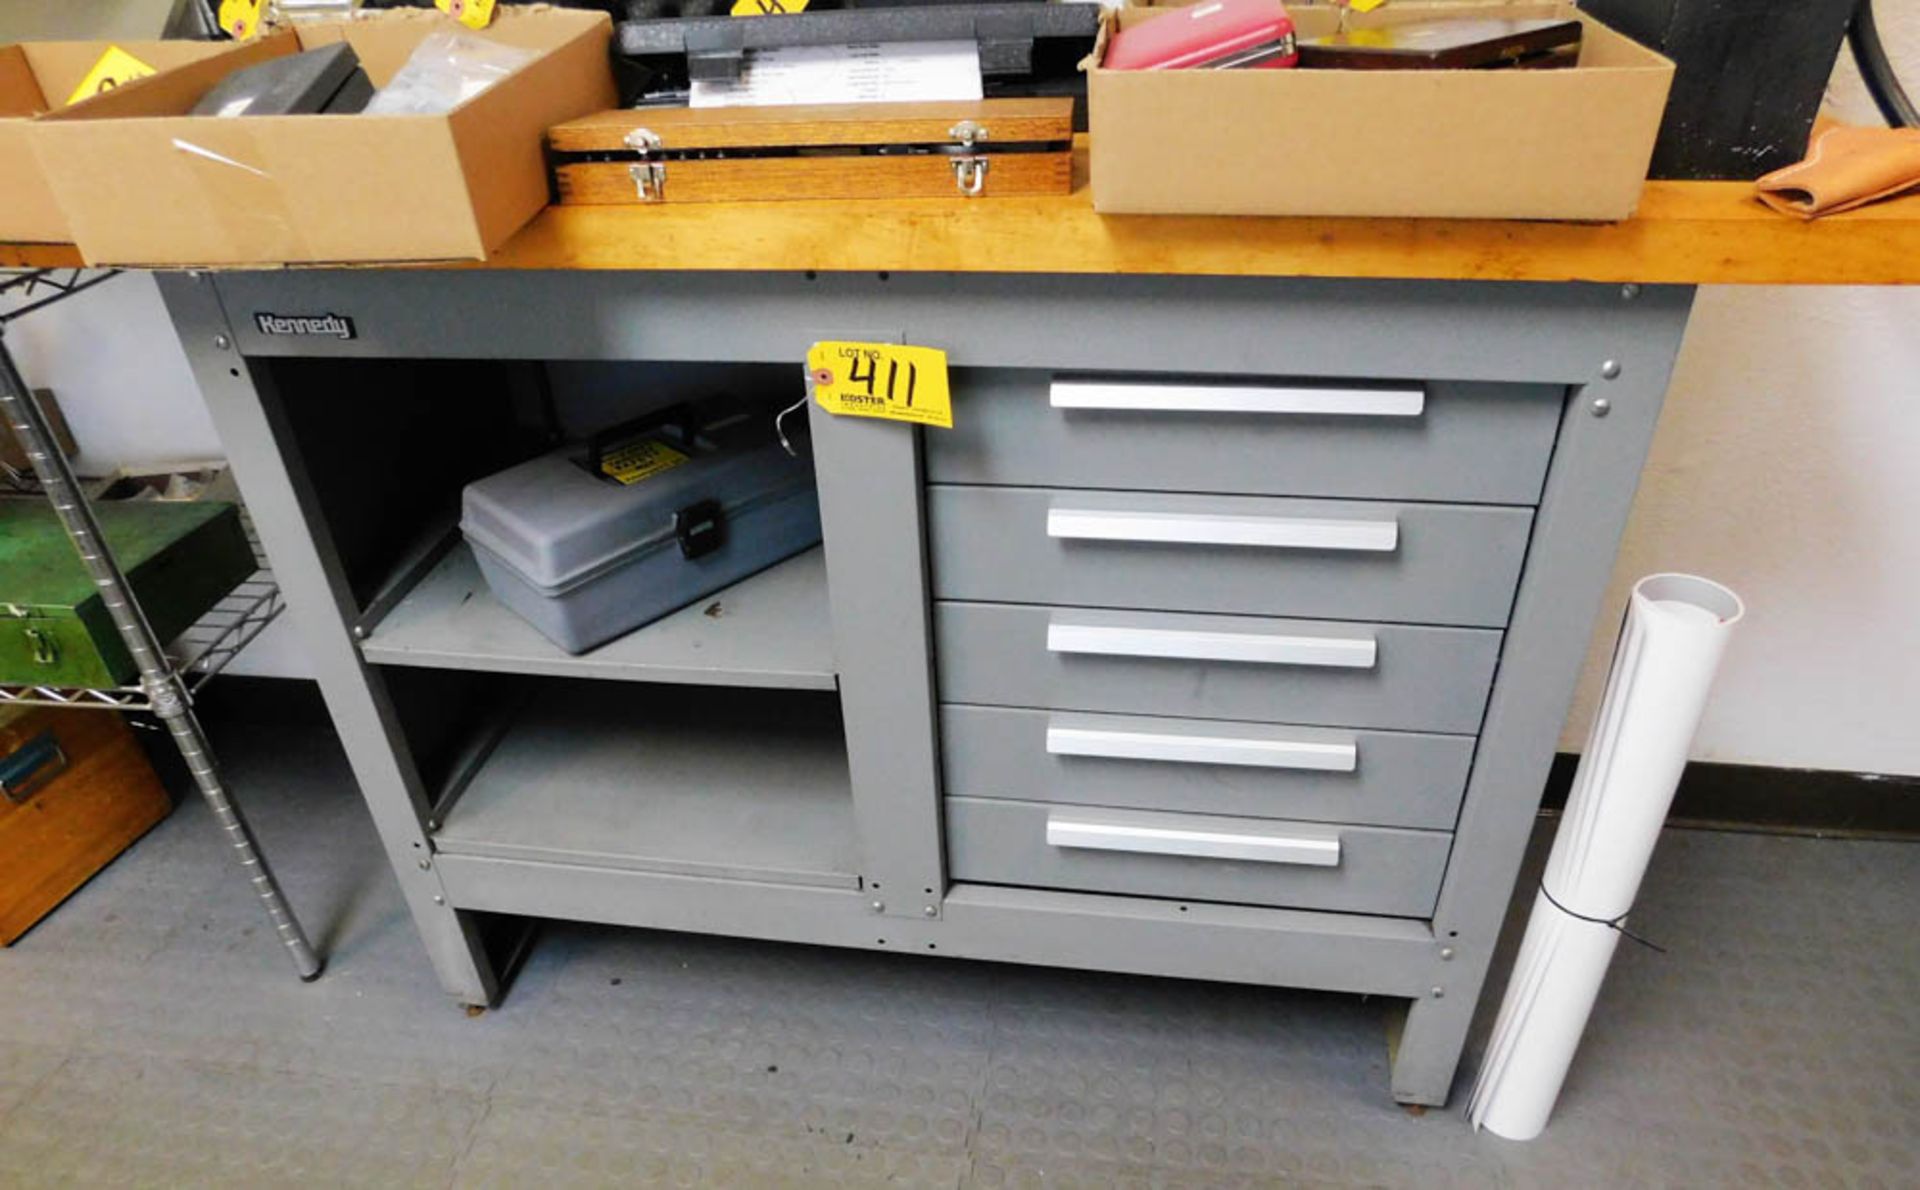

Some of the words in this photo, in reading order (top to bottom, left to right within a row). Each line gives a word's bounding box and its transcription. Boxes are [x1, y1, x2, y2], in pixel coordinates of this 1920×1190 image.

[258, 315, 350, 339] Kennedy
[838, 346, 860, 359] LOT
[848, 356, 917, 408] 411
